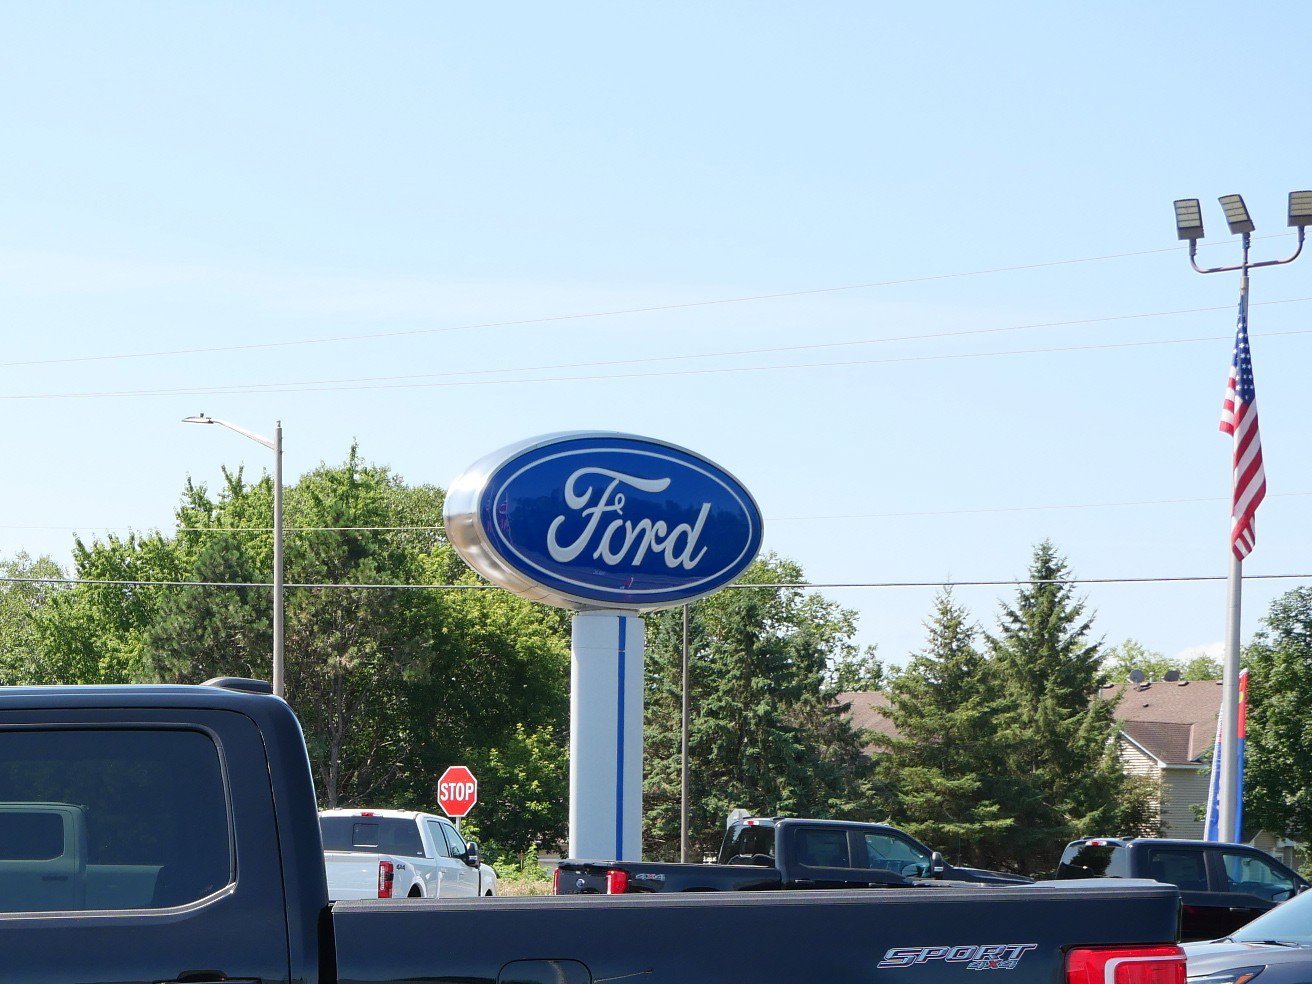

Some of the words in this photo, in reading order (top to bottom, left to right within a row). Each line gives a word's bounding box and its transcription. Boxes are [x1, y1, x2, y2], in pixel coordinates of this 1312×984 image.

[547, 467, 711, 570] Ford
[440, 782, 475, 801] STOP
[876, 943, 1038, 969] SPORT
